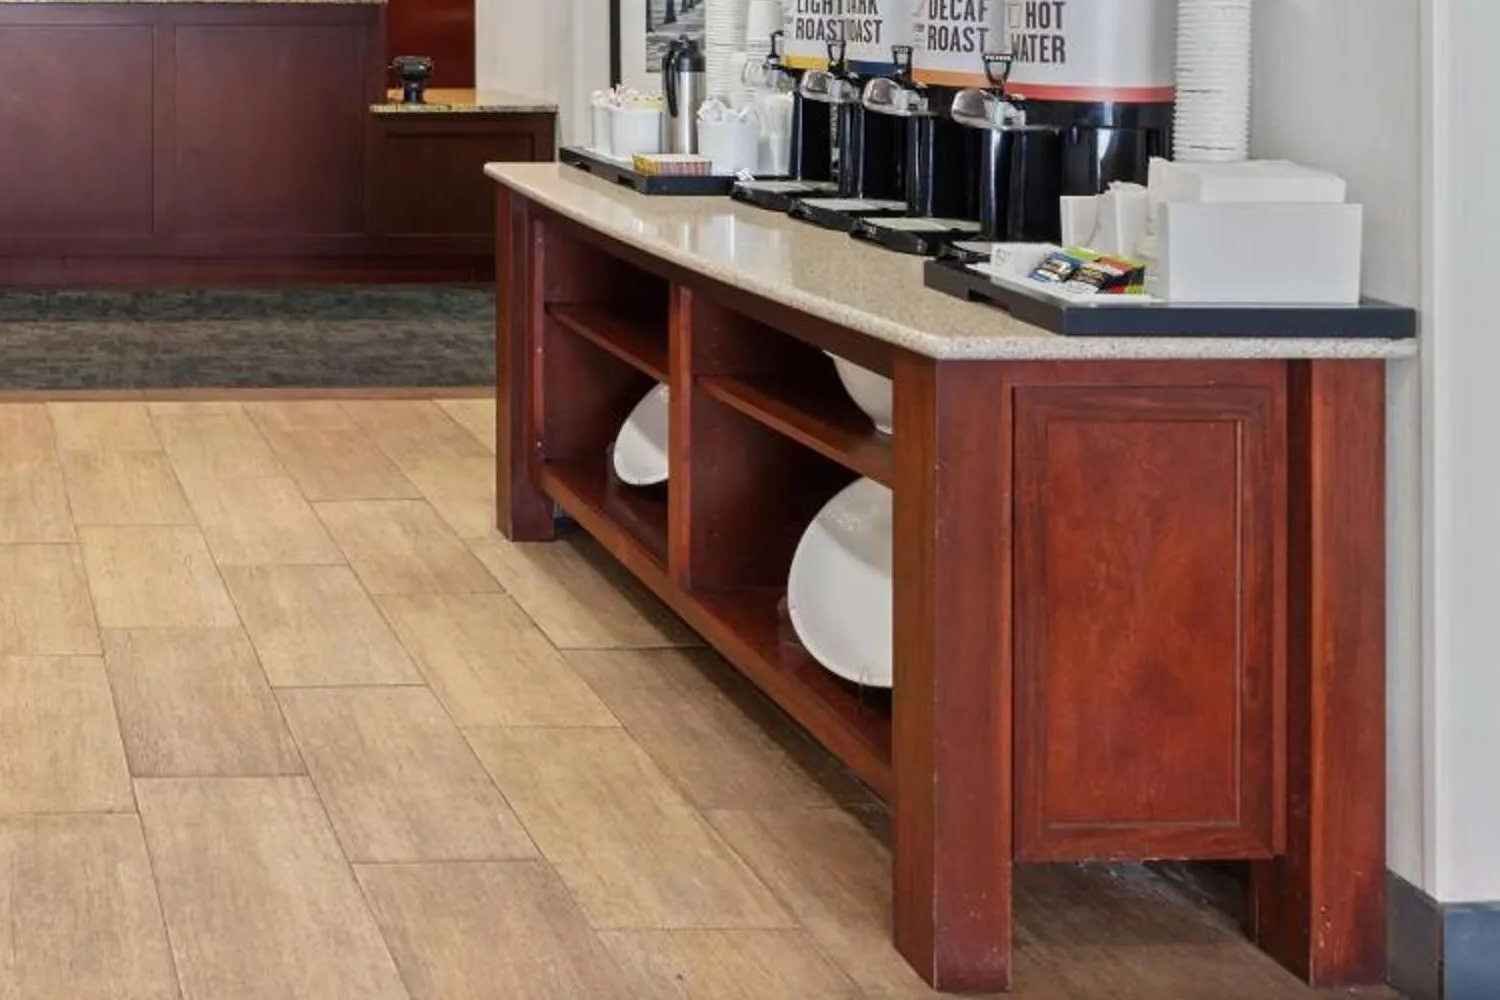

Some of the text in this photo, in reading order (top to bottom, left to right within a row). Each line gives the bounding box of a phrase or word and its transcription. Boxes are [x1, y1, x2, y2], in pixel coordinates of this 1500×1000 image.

[795, 17, 845, 41] ROAST
[1025, 1, 1067, 30] HOT
[927, 24, 990, 53] ROAST
[1010, 33, 1066, 63] WATER
